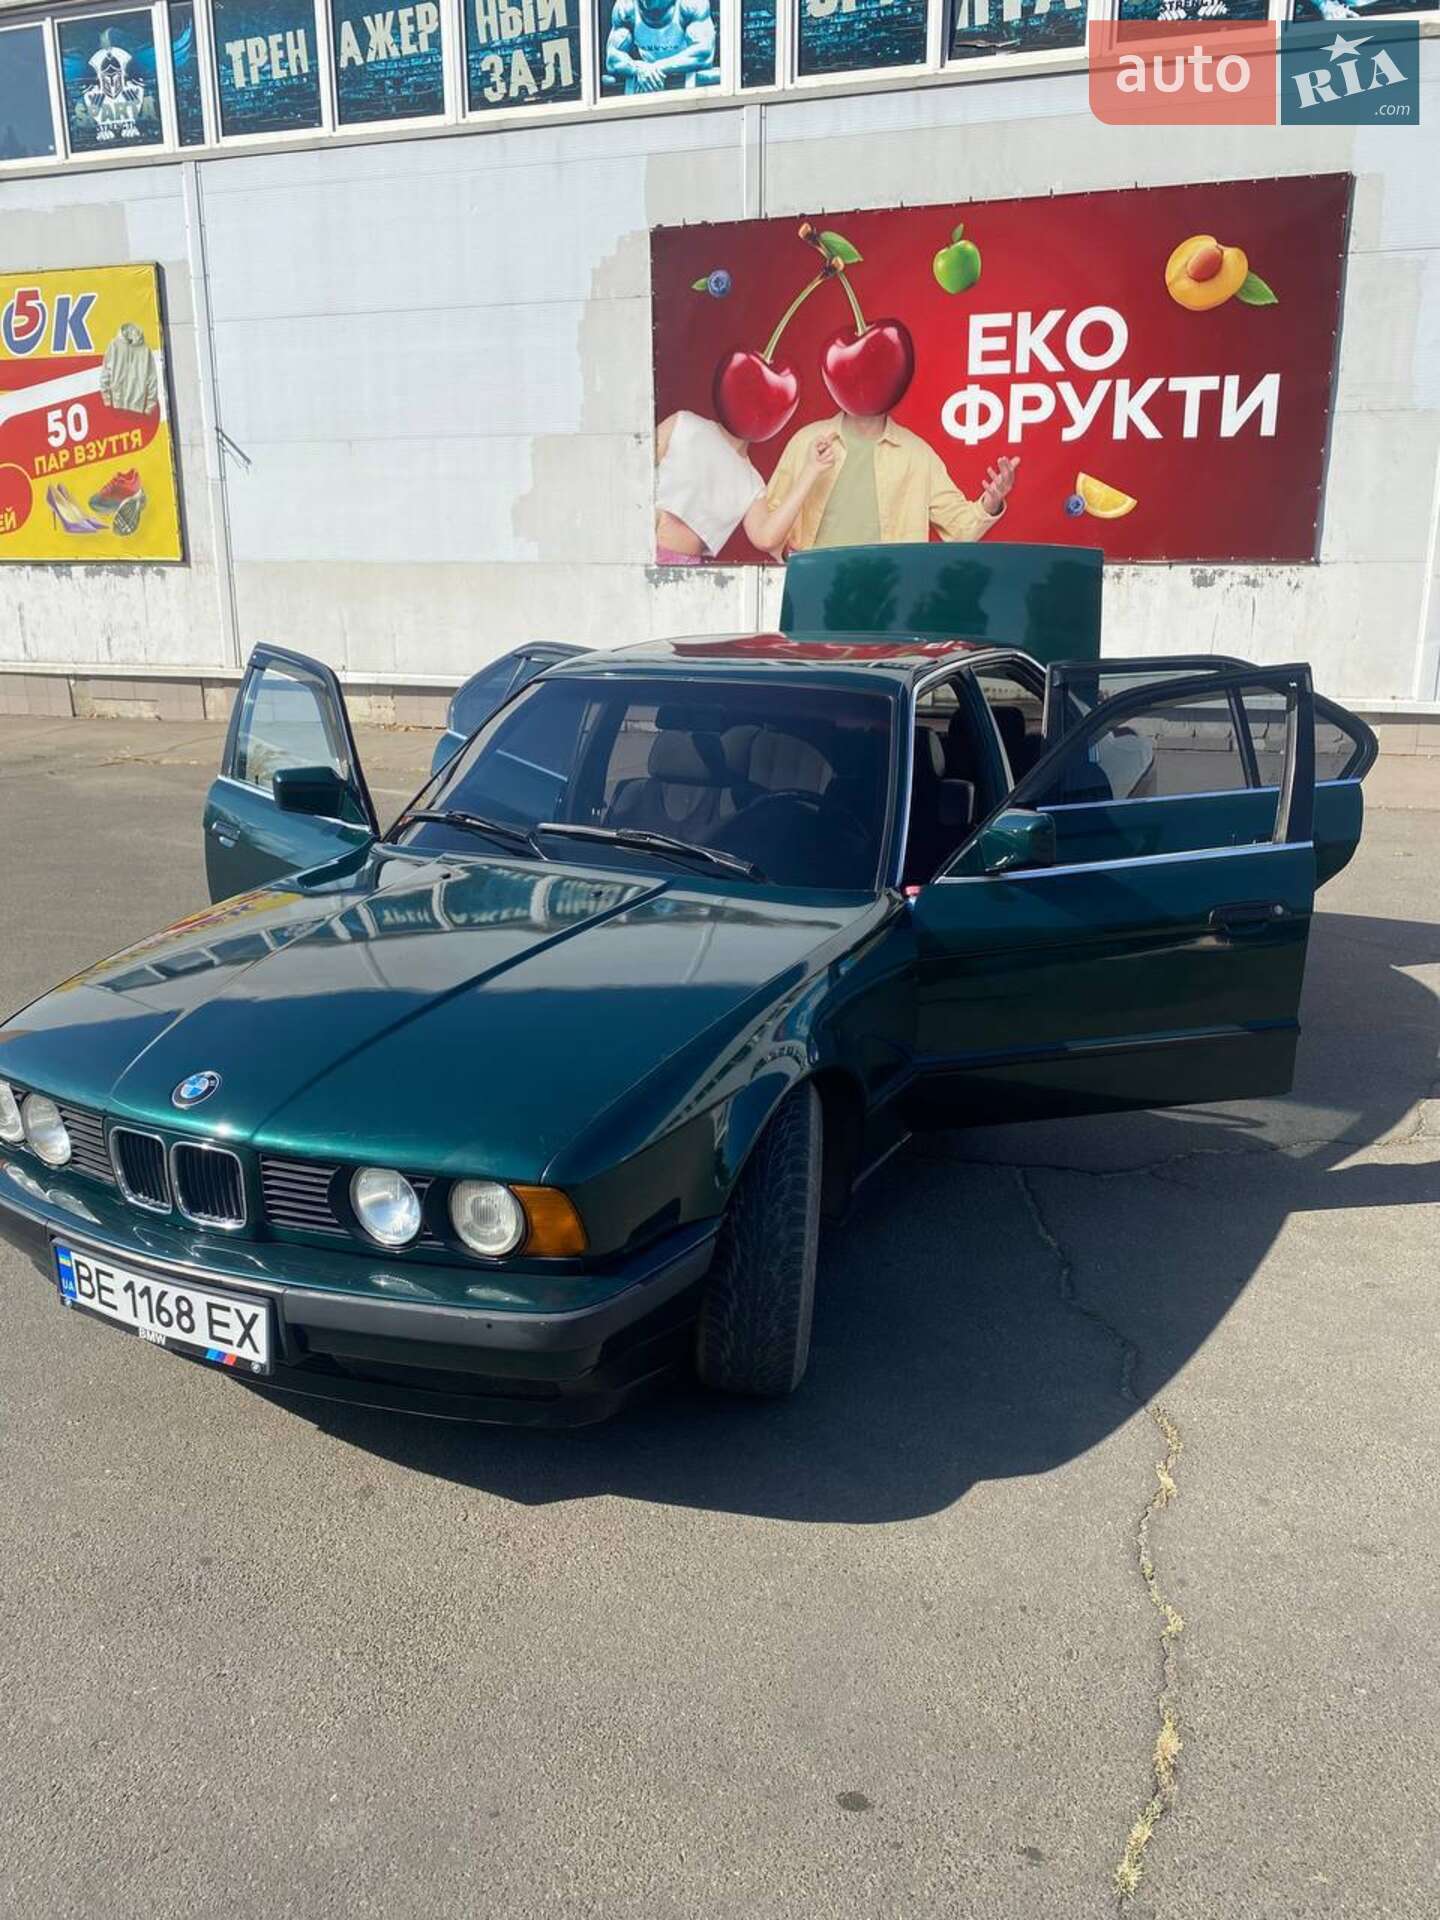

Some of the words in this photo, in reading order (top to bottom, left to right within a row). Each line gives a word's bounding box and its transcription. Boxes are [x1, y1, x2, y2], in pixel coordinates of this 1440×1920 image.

[225, 29, 309, 89] ТРЕН
[339, 2, 439, 68] АЖЕР
[480, 38, 574, 102] ЗАЛ
[968, 306, 1128, 374] ЕКО
[47, 403, 89, 447] 50
[941, 373, 1281, 445] ФРУКТИ
[34, 448, 70, 475] ПАР
[75, 429, 143, 466] ВЗУТТЯ
[62, 1280, 74, 1293] UA
[76, 1258, 118, 1311] BE
[123, 1280, 196, 1334] 1168
[207, 1300, 260, 1354] EX
